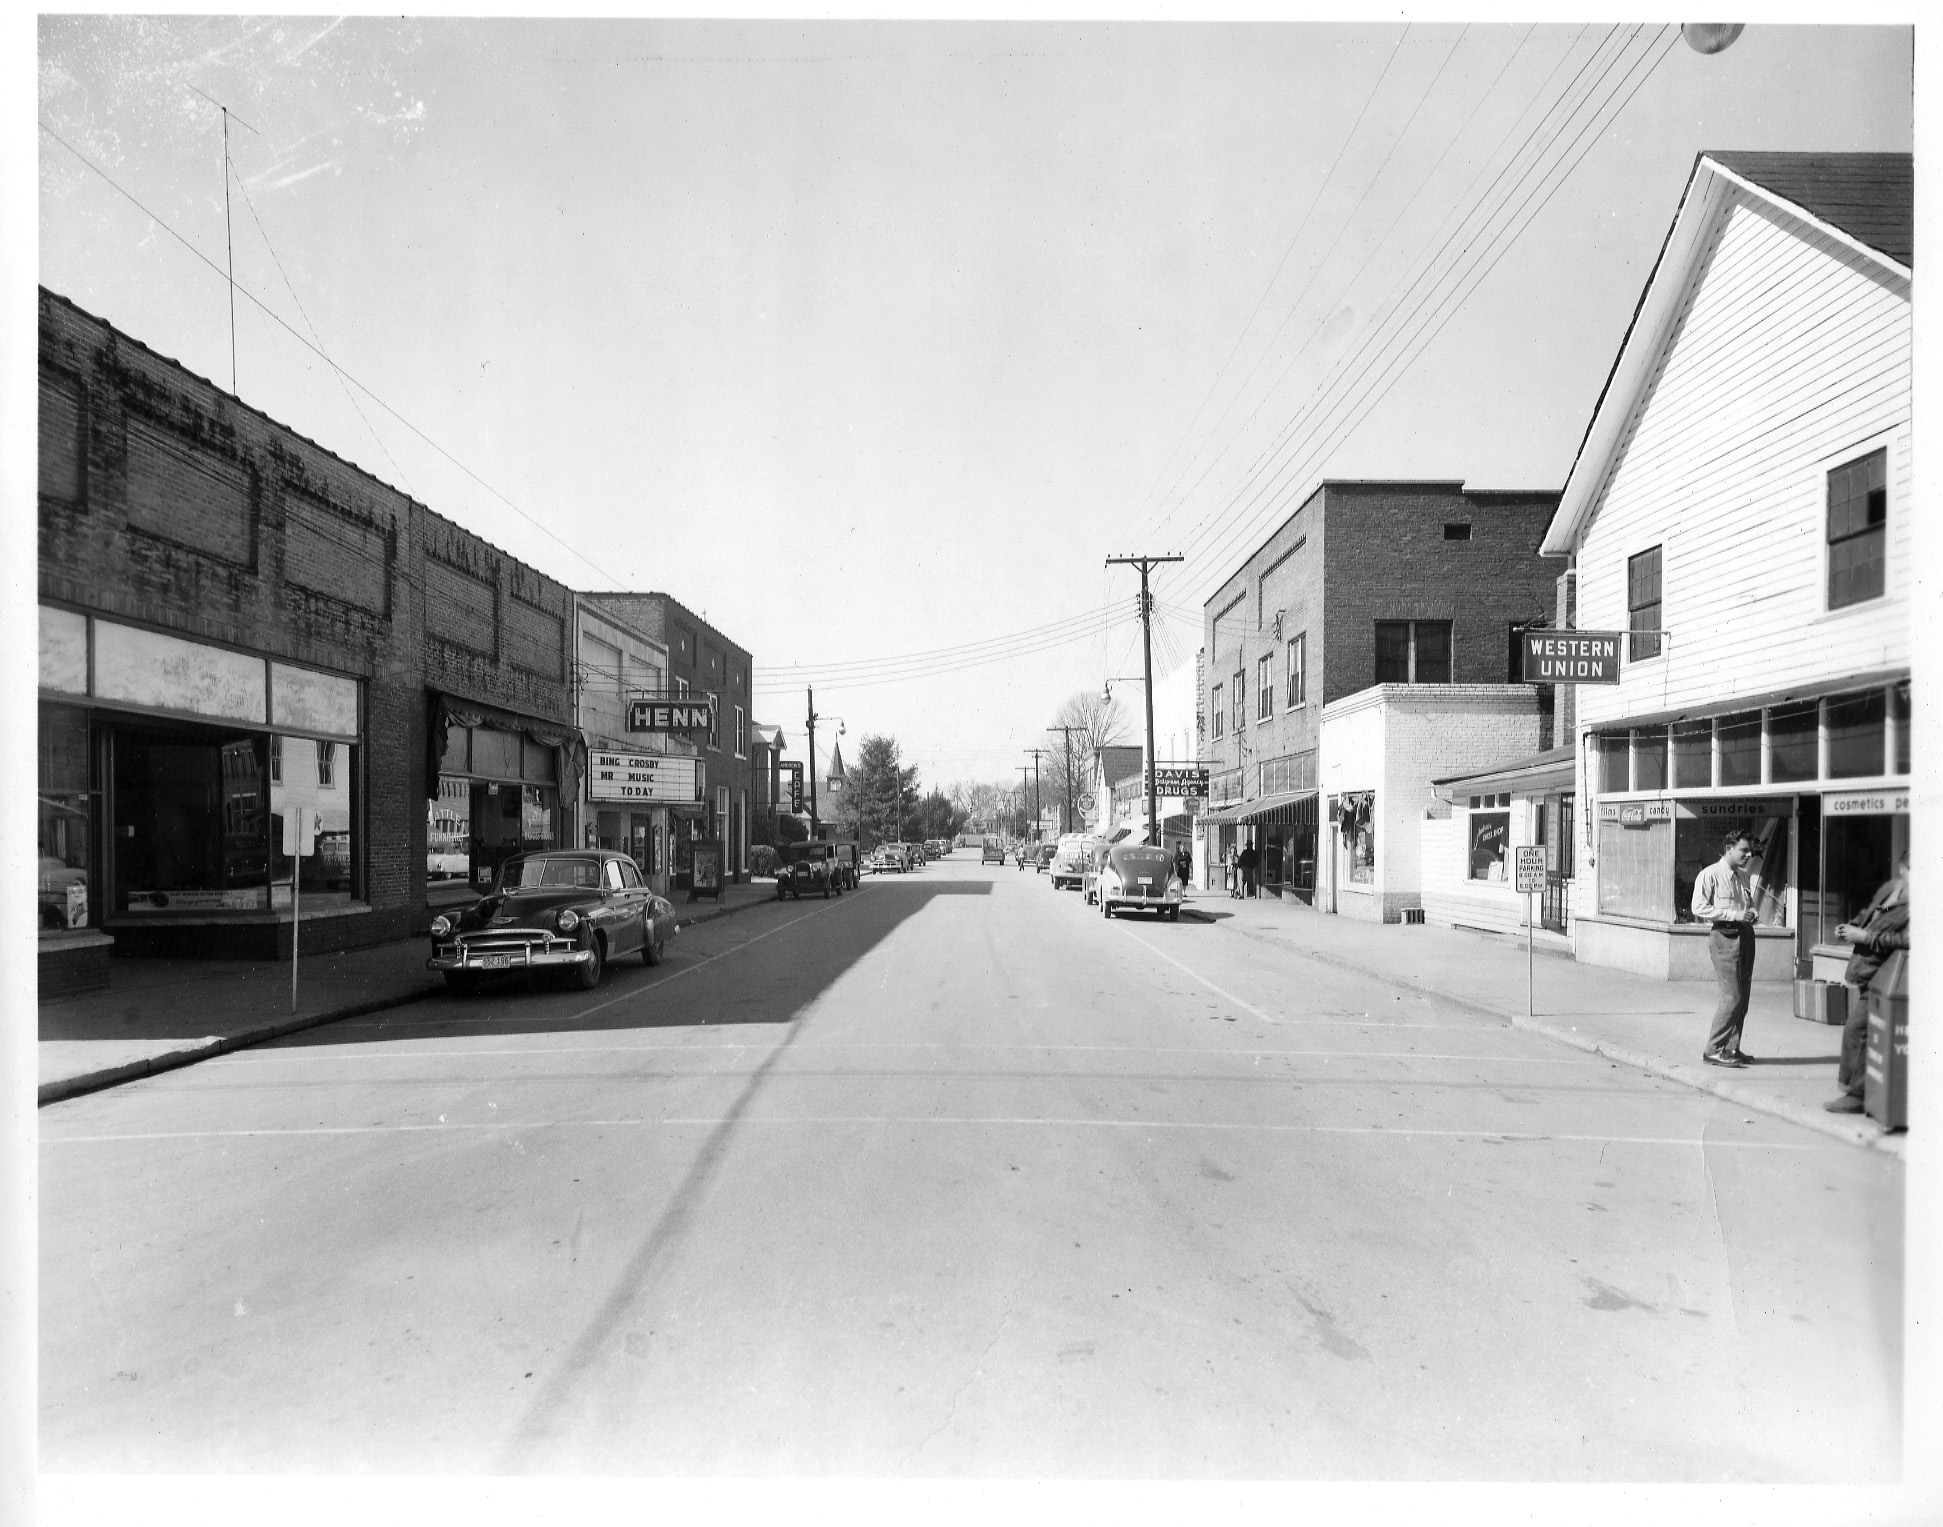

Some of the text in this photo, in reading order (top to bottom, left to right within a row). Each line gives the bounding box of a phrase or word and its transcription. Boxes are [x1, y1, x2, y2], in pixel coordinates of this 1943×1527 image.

[1531, 639, 1614, 657] WESTERN
[1541, 660, 1603, 677] UNION
[635, 707, 707, 727] HENN
[600, 757, 659, 768] BING CROSBY
[600, 771, 654, 782] MR MUSIC
[1155, 770, 1200, 778] DAVIS
[621, 786, 653, 796] TODAY
[1156, 786, 1198, 795] DRUGS
[1702, 804, 1764, 815] sundries
[1834, 798, 1885, 811] cosmetics
[1600, 806, 1616, 816] films
[1649, 806, 1670, 817] candy
